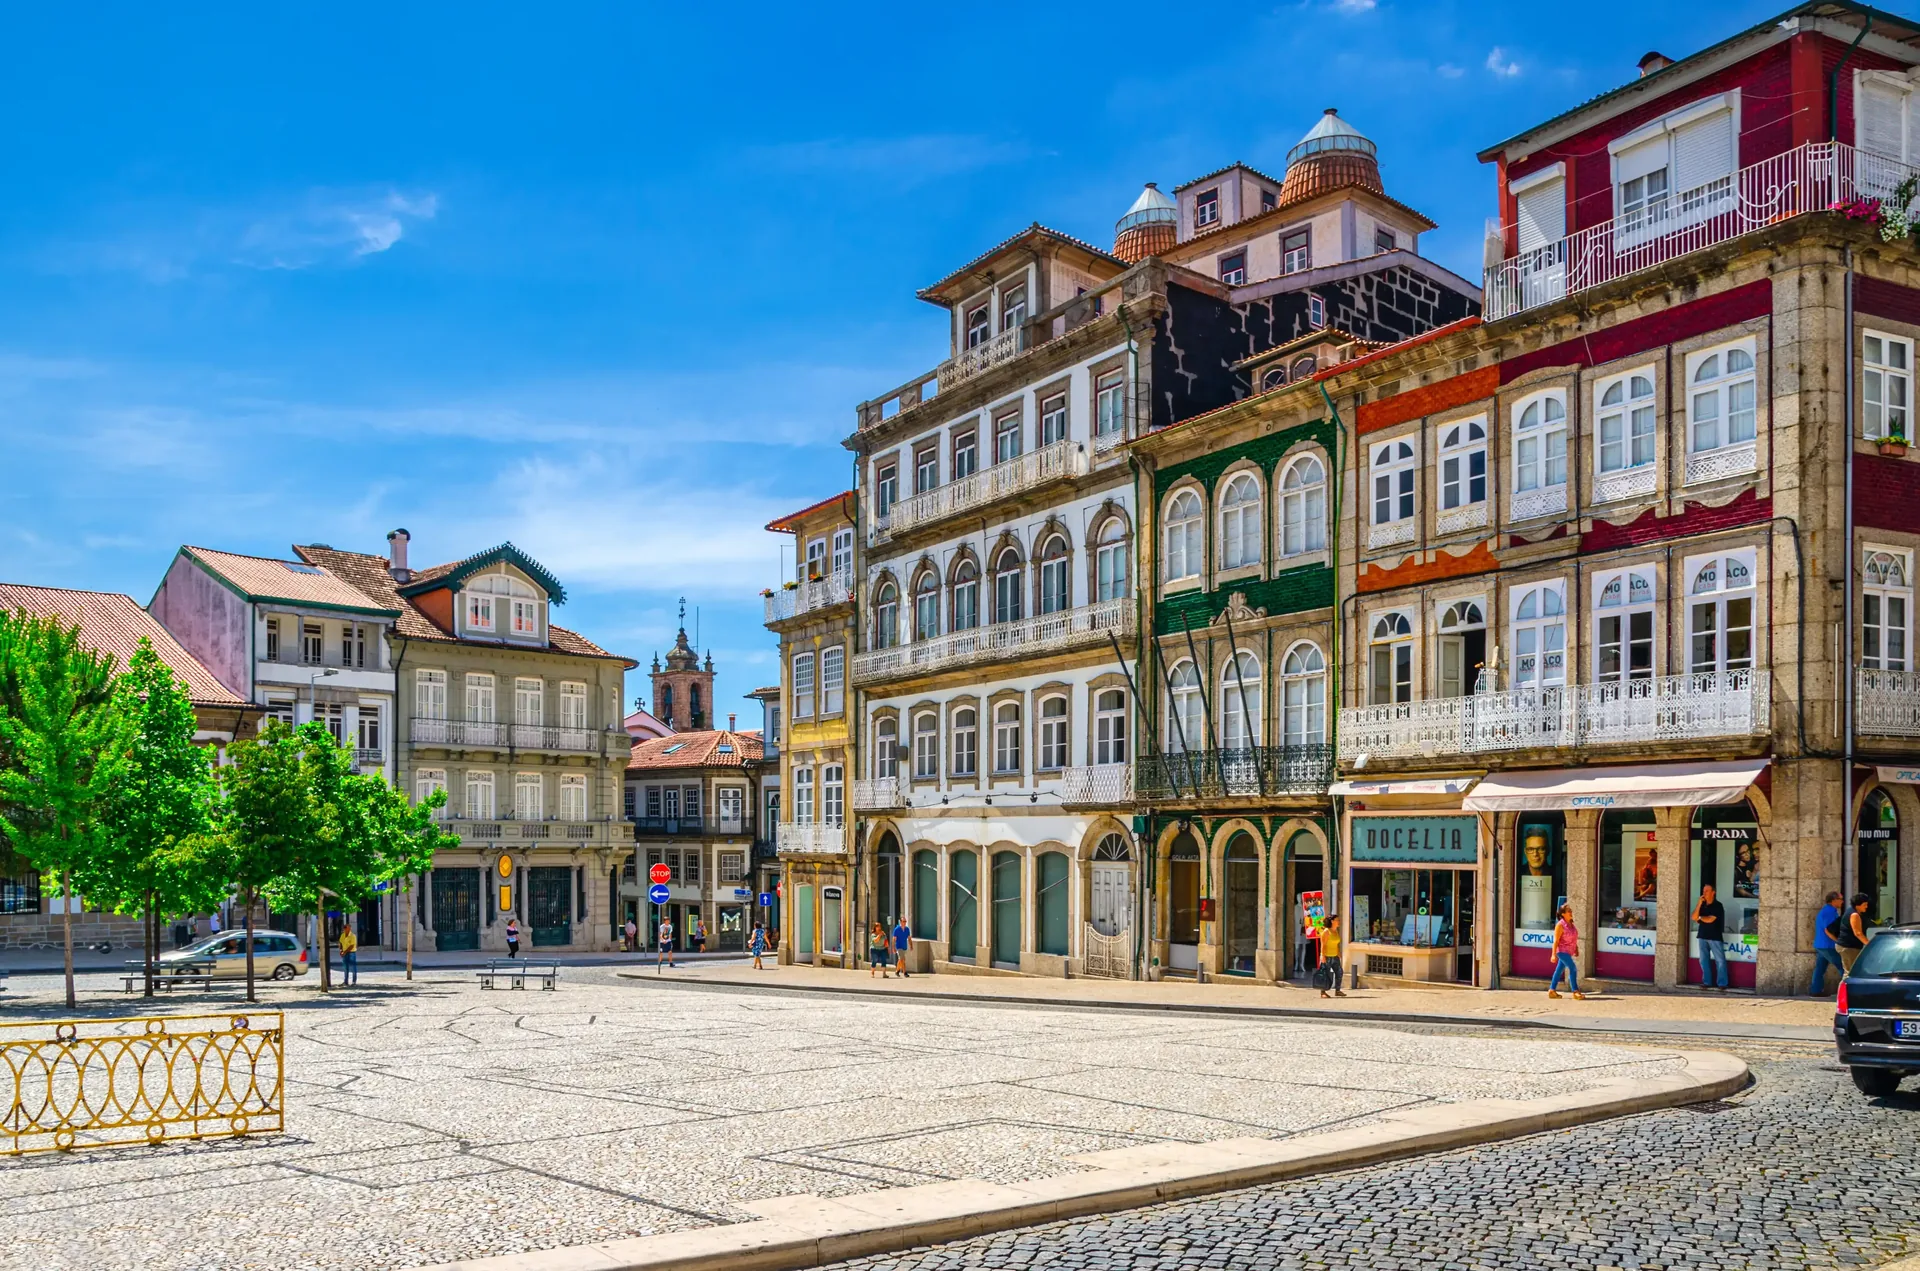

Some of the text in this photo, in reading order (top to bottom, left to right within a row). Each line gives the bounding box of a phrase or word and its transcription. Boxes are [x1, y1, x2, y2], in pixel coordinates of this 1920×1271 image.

[1699, 566, 1748, 583] MOACO
[1605, 579, 1648, 594] MOACO
[1521, 655, 1561, 669] MOACO
[1703, 829, 1749, 839] PRADA
[651, 869, 670, 878] STOP
